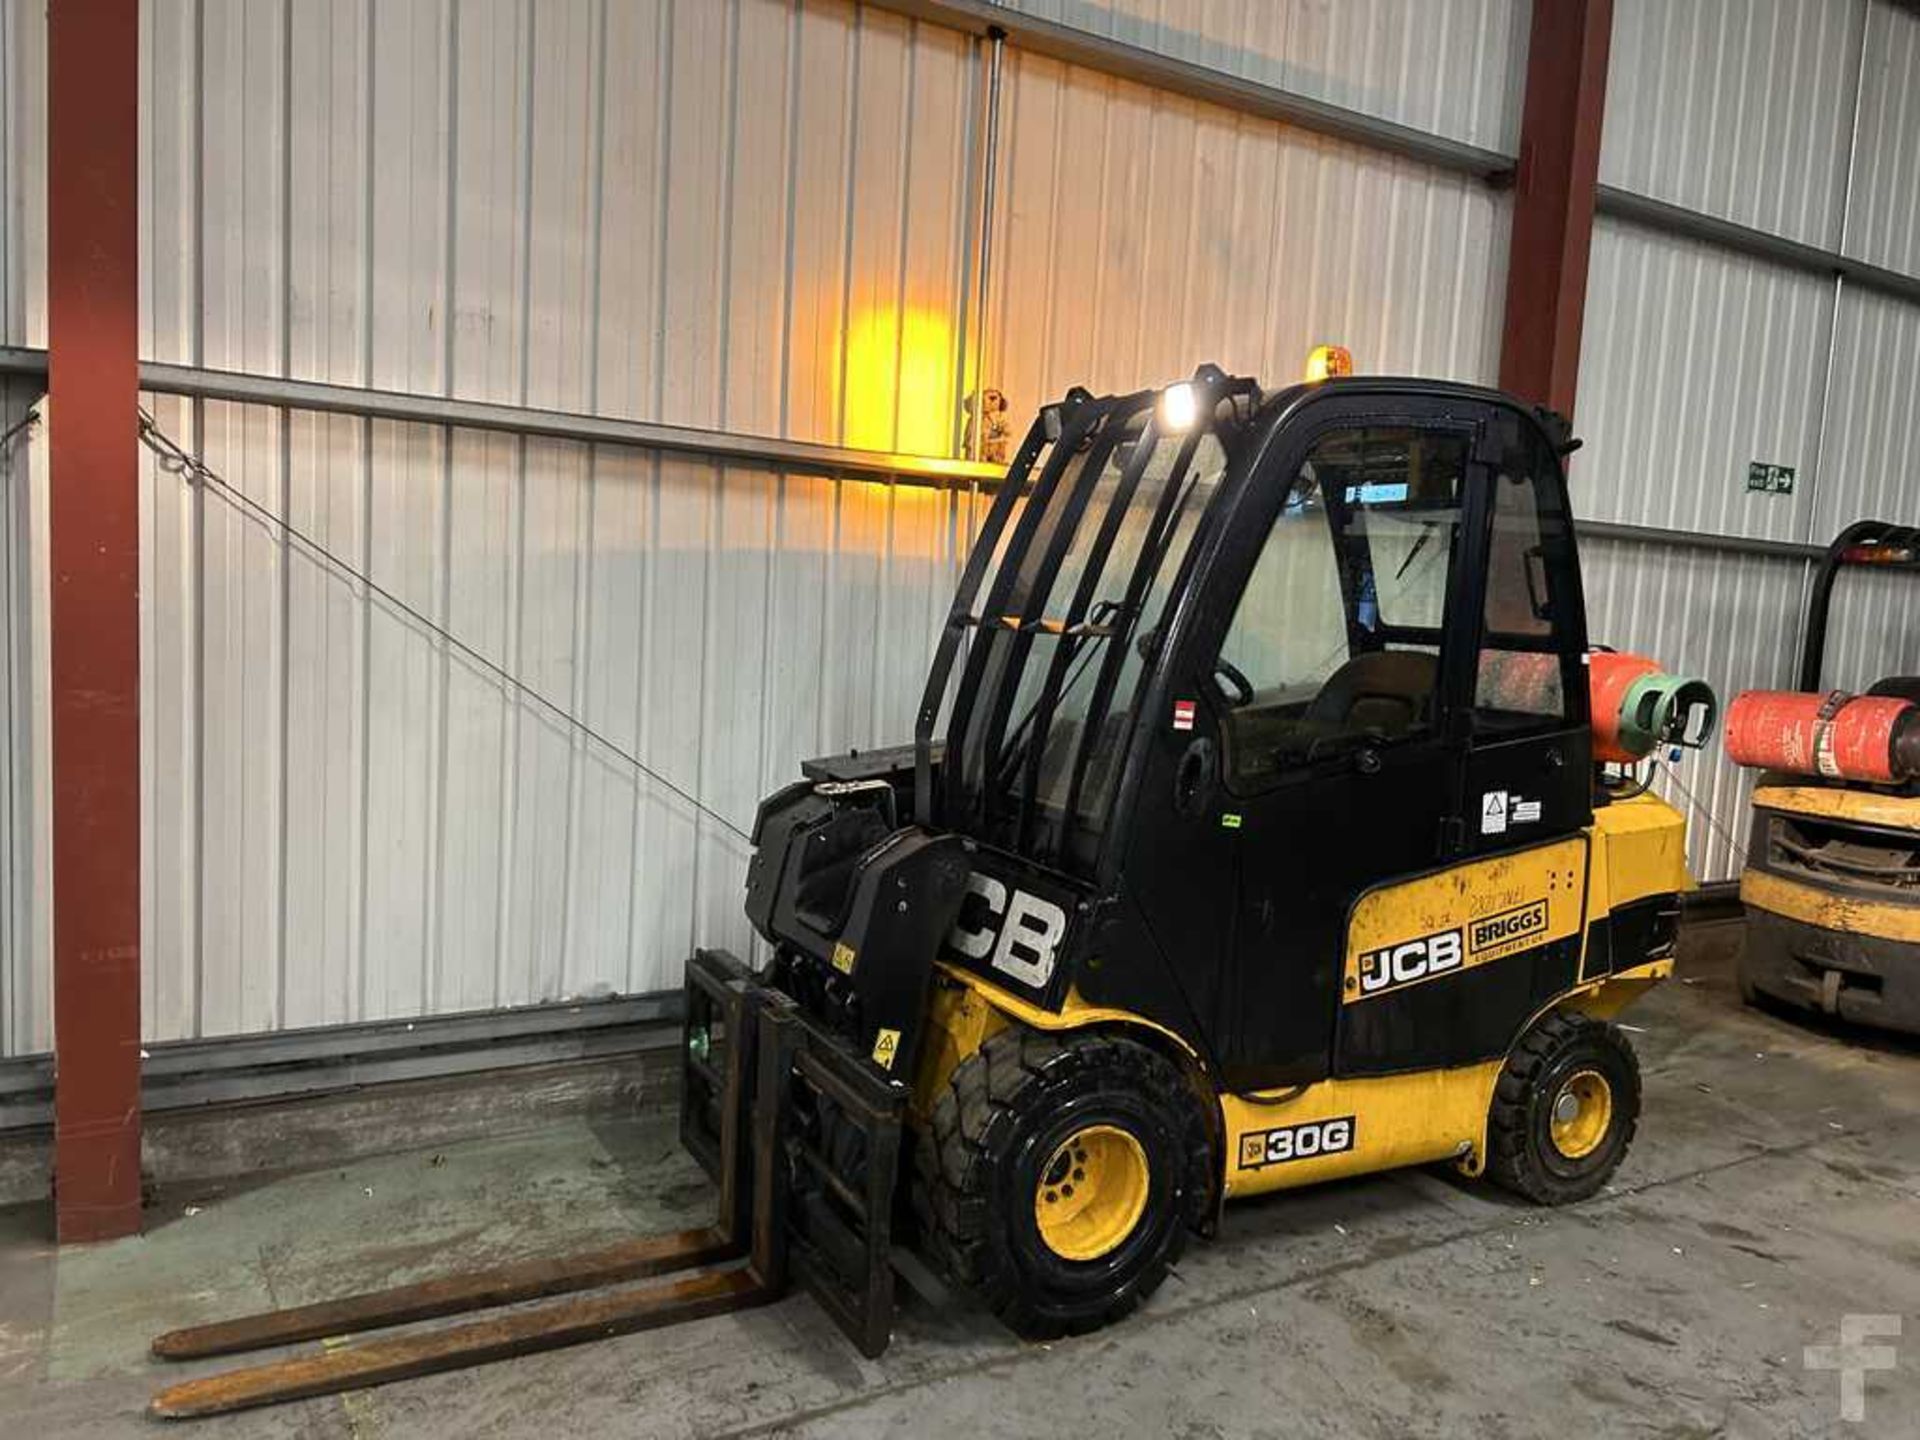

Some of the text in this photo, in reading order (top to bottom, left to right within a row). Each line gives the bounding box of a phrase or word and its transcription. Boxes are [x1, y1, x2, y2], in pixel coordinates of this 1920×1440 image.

[951, 871, 1066, 989] CB
[1475, 908, 1542, 945] BRIGGS
[1362, 931, 1462, 991] JCB
[1267, 1120, 1349, 1161] 30G
